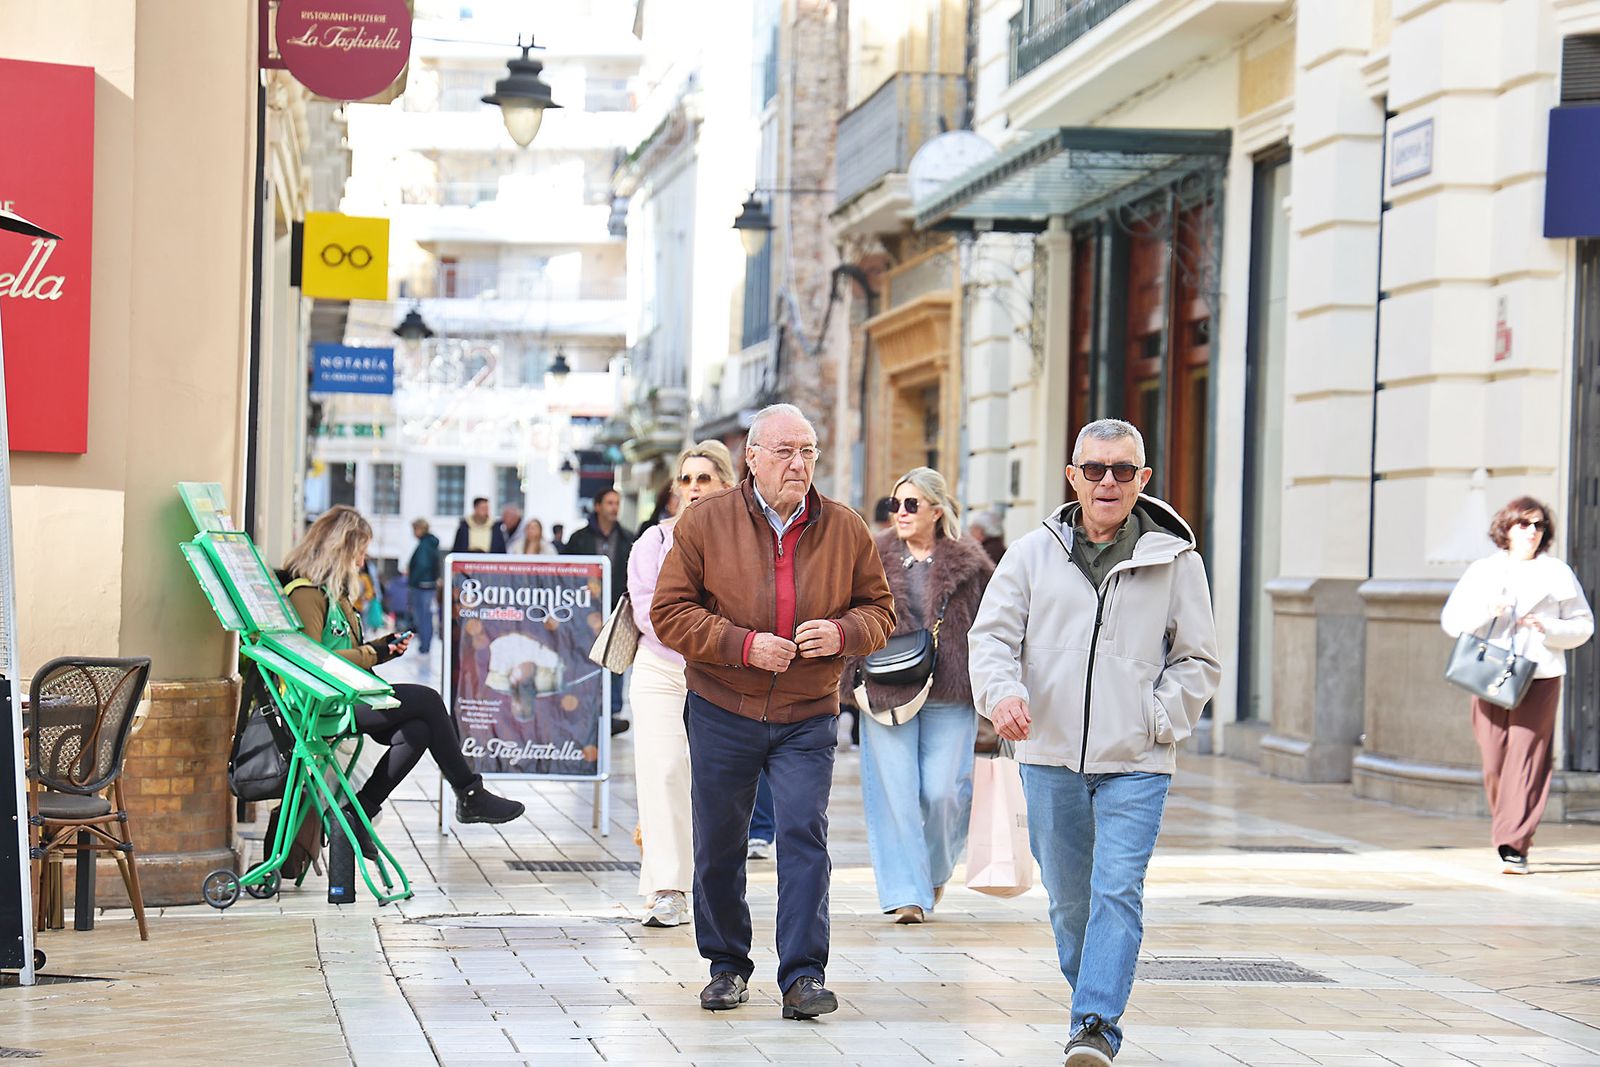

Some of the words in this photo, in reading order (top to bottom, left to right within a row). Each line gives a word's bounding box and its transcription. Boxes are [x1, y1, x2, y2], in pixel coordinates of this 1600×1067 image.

[287, 23, 318, 47] La
[319, 26, 400, 51] Tagliatella
[459, 609, 479, 618] CON
[461, 737, 486, 758] La
[487, 738, 585, 766] Tagliatella
